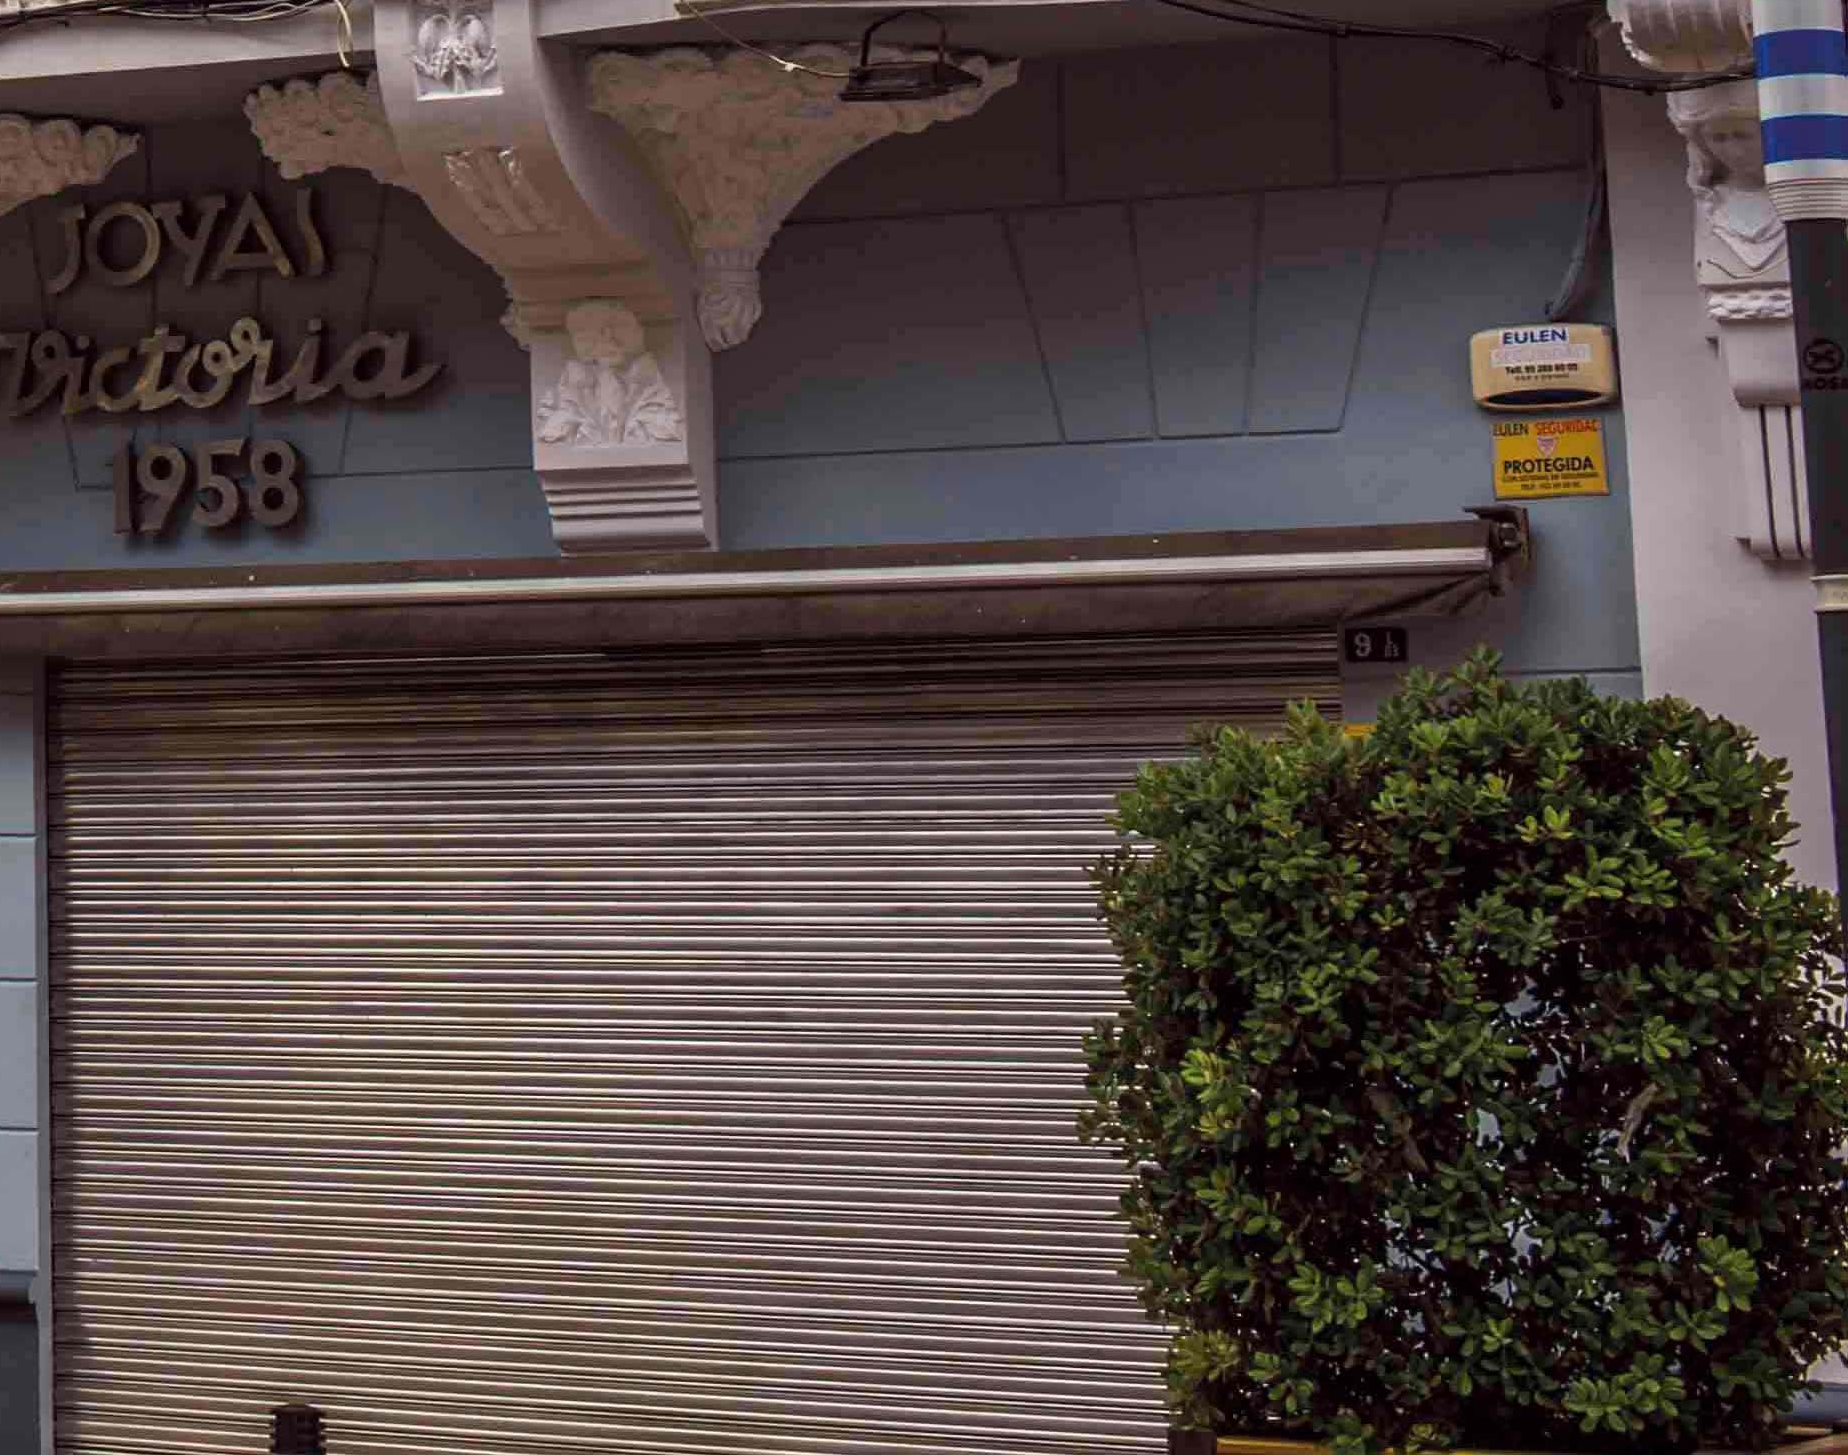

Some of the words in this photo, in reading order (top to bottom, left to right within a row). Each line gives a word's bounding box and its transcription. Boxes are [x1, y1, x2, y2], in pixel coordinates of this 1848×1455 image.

[1502, 329, 1568, 345] EULEN
[1503, 456, 1595, 474] PROTEGIDA
[110, 436, 306, 536] 1958
